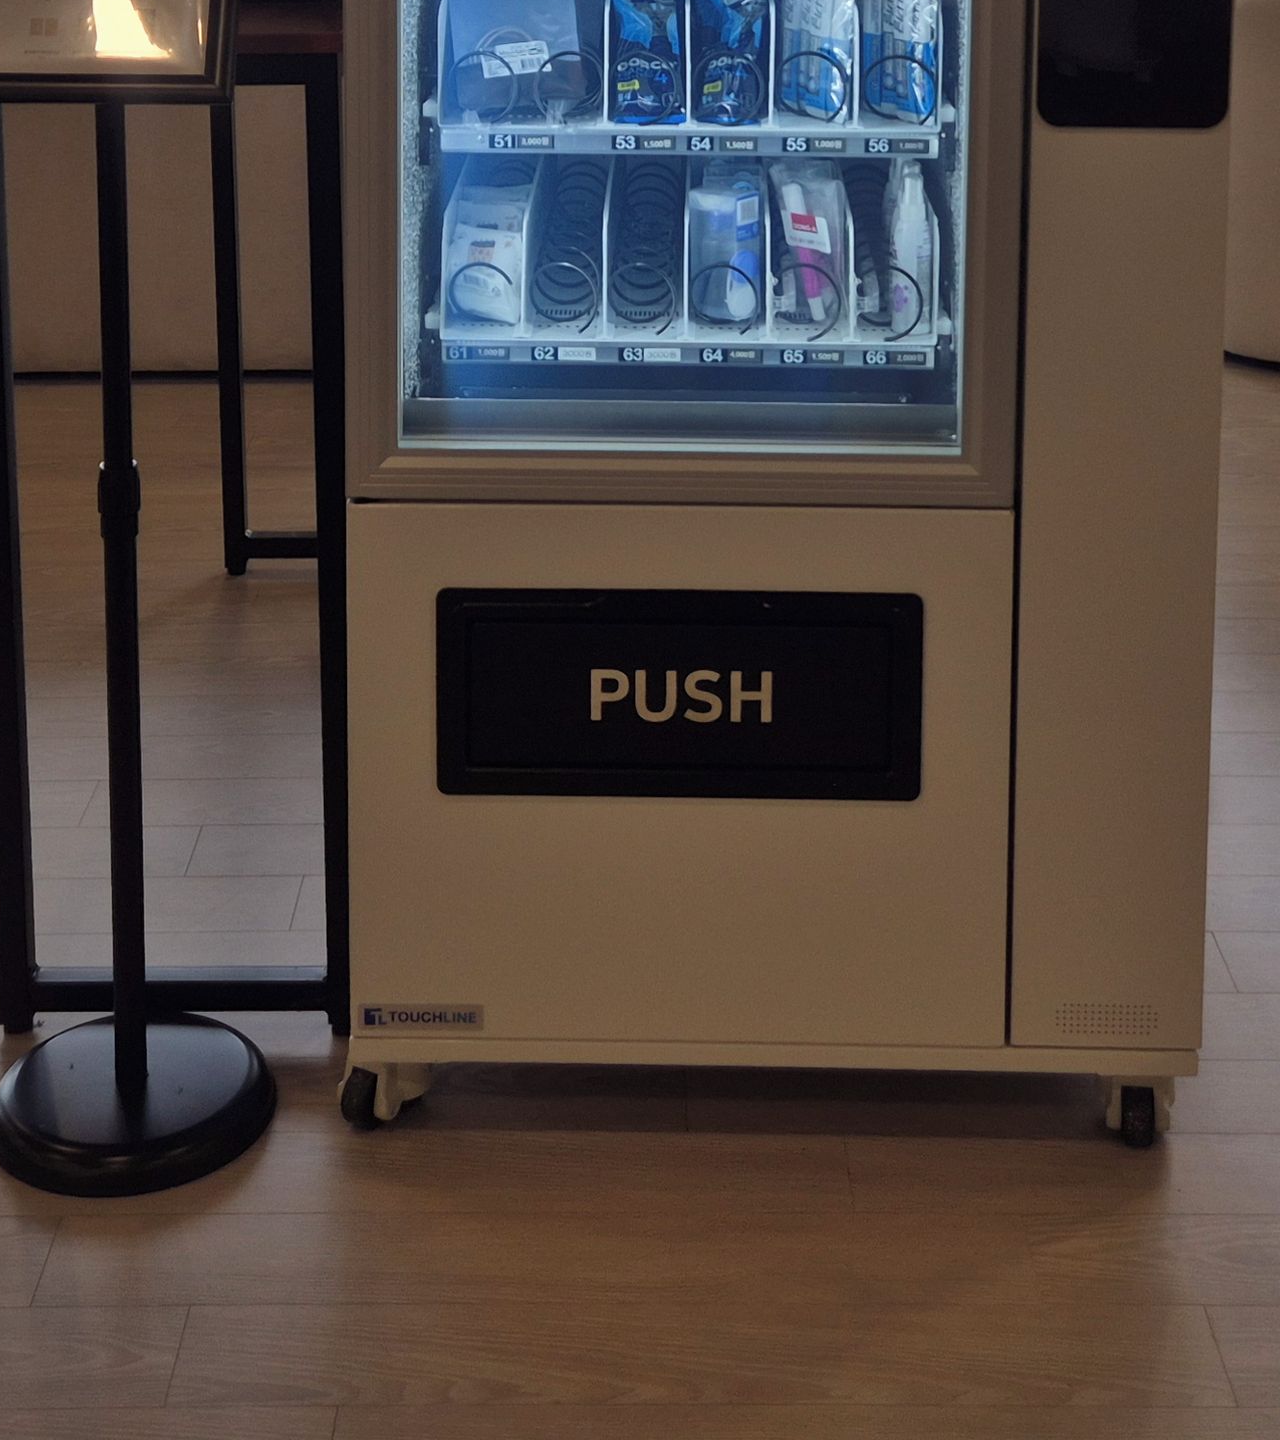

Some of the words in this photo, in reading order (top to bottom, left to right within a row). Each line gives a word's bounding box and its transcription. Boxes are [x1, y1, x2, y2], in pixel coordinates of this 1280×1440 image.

[494, 135, 513, 148] 51
[615, 135, 636, 149] 53
[690, 137, 711, 151] 54
[786, 137, 807, 151] 55
[868, 139, 889, 152] 56
[449, 347, 468, 359] 61
[534, 346, 554, 360] 62
[623, 347, 643, 361] 63
[702, 349, 723, 362] 64
[783, 350, 804, 363] 65
[866, 350, 886, 363] 66
[590, 669, 773, 723] PUSH
[388, 1011, 477, 1023] TOUCHLINE
